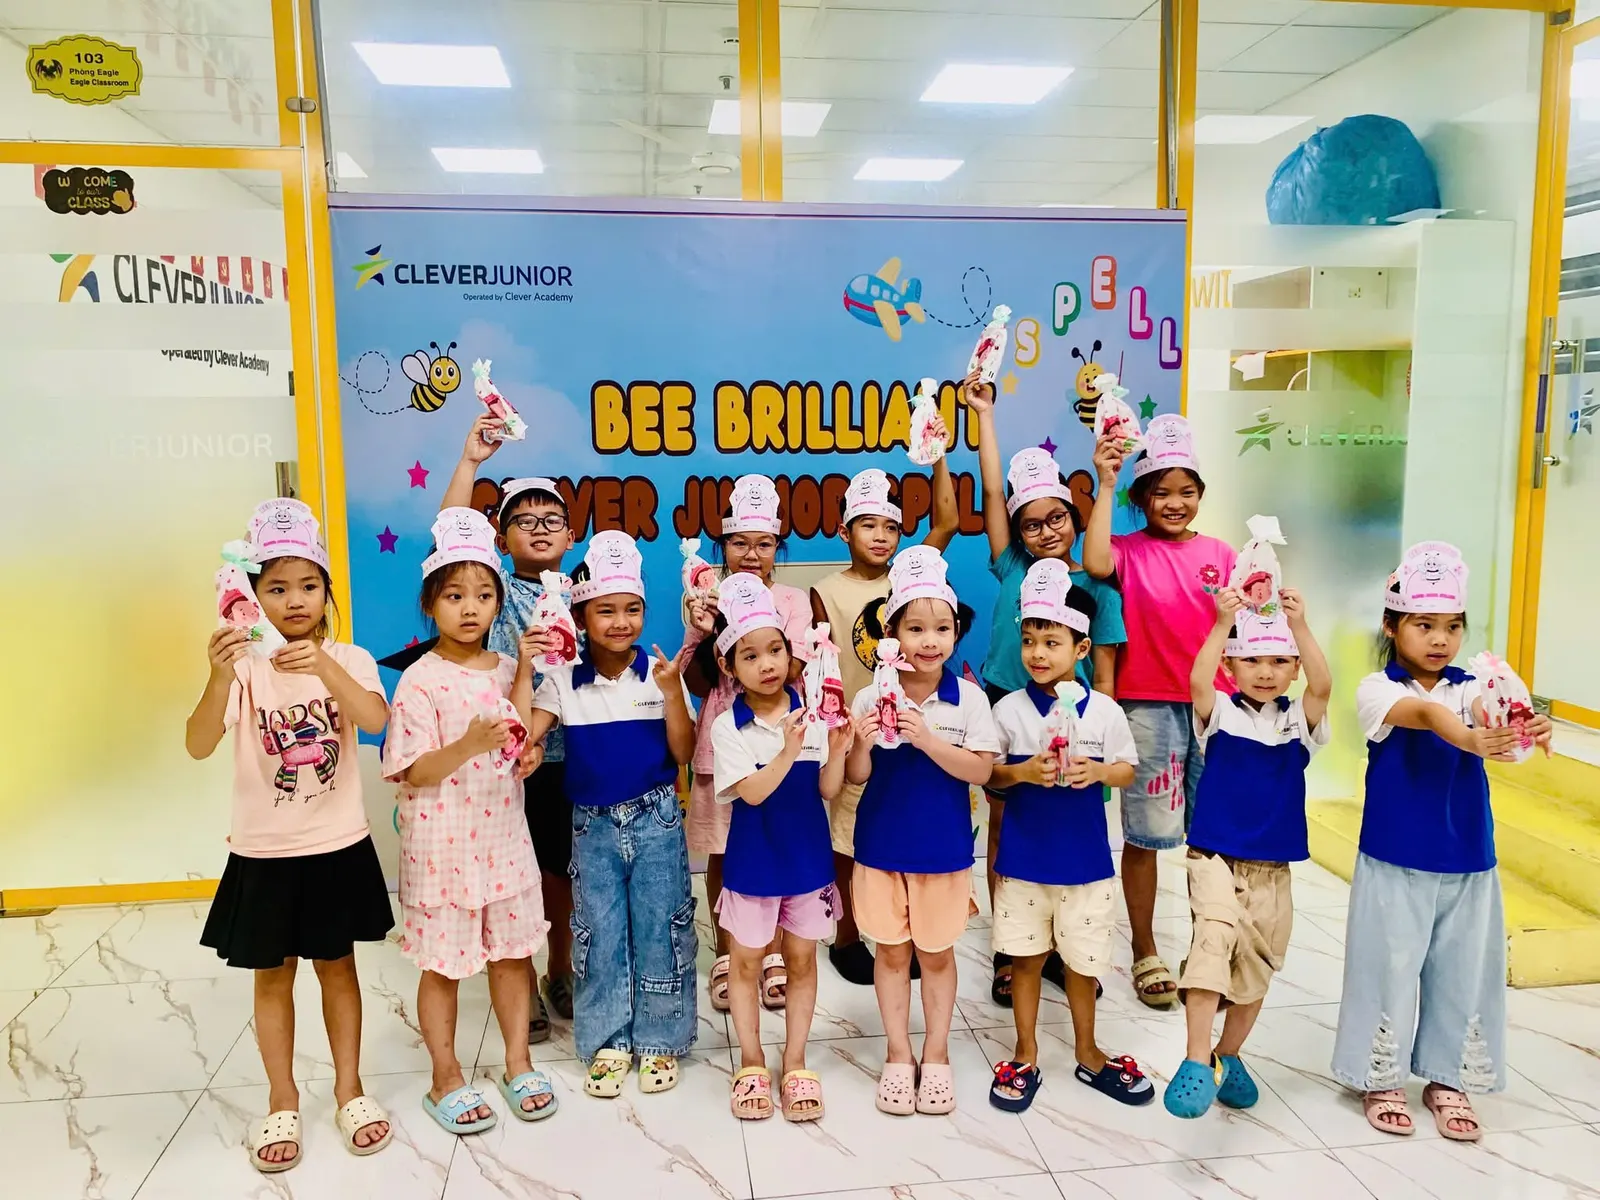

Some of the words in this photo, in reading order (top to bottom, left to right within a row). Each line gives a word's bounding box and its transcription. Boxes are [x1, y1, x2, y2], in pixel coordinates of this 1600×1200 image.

[75, 52, 104, 64] 103
[97, 69, 120, 77] Eagle
[70, 79, 90, 87] Eagle
[92, 79, 129, 87] Classroom
[58, 176, 118, 188] WCOME
[68, 196, 111, 209] CLASS
[394, 263, 574, 287] CLEVERJUNIOR
[463, 293, 499, 302] Operated
[499, 293, 504, 303] by
[505, 292, 532, 302] Clever
[534, 292, 574, 304] Academy
[215, 350, 239, 367] Clever
[239, 351, 270, 377] Academy
[590, 380, 697, 456] BEE
